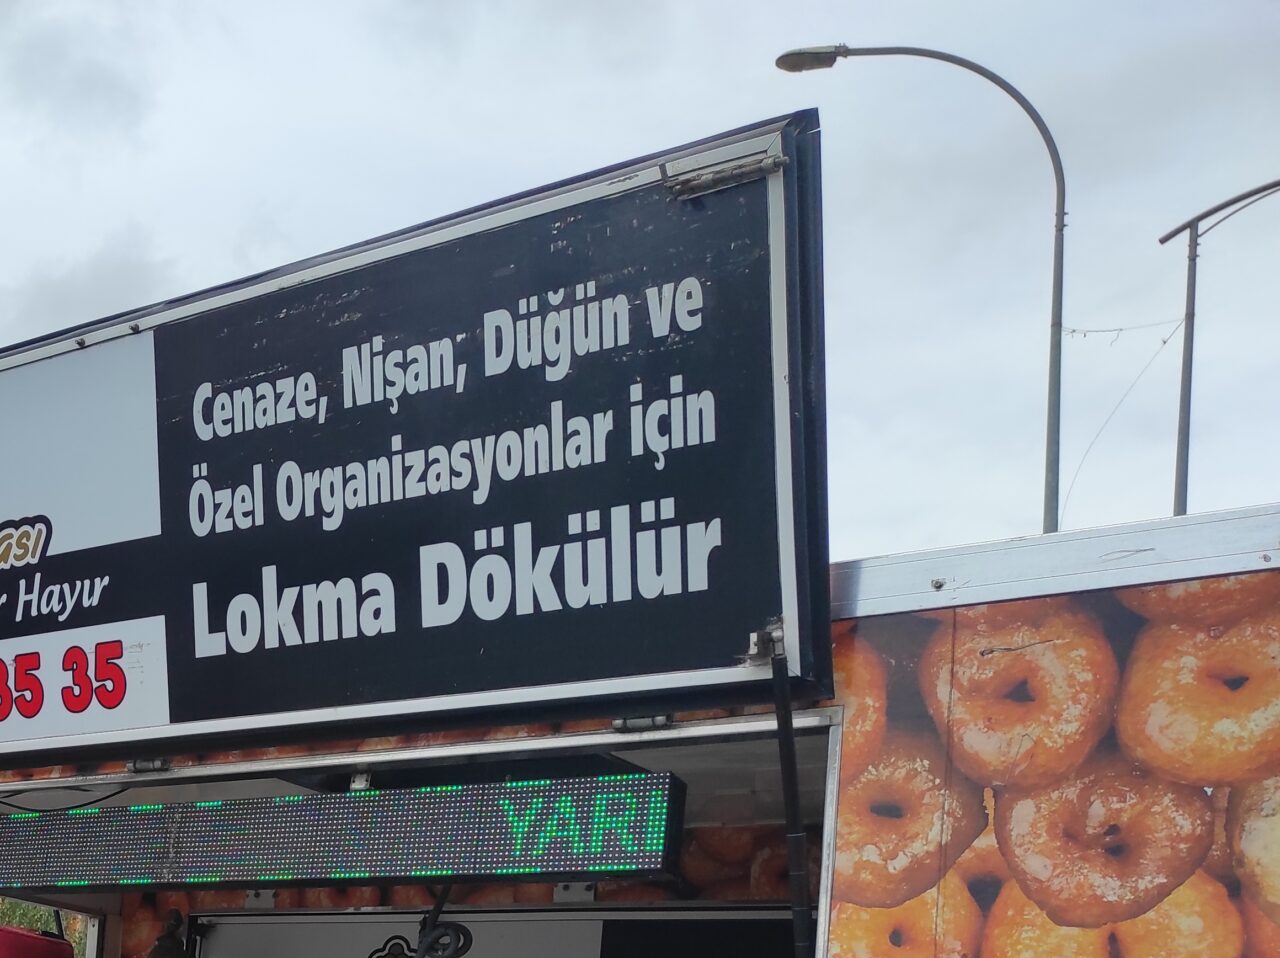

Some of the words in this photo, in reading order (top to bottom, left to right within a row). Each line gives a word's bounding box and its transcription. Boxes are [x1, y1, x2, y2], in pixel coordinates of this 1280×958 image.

[192, 370, 328, 441] Cenaze,
[342, 334, 467, 414] Nişan,
[483, 281, 629, 382] Düğün
[646, 277, 704, 338] ve
[189, 463, 263, 538] Özel
[276, 400, 613, 532] Organizasyonlar
[630, 375, 716, 470] için
[17, 574, 109, 623] Hayır
[192, 565, 396, 658] Lokma
[420, 497, 721, 628] Dökülür
[61, 640, 127, 714] 35
